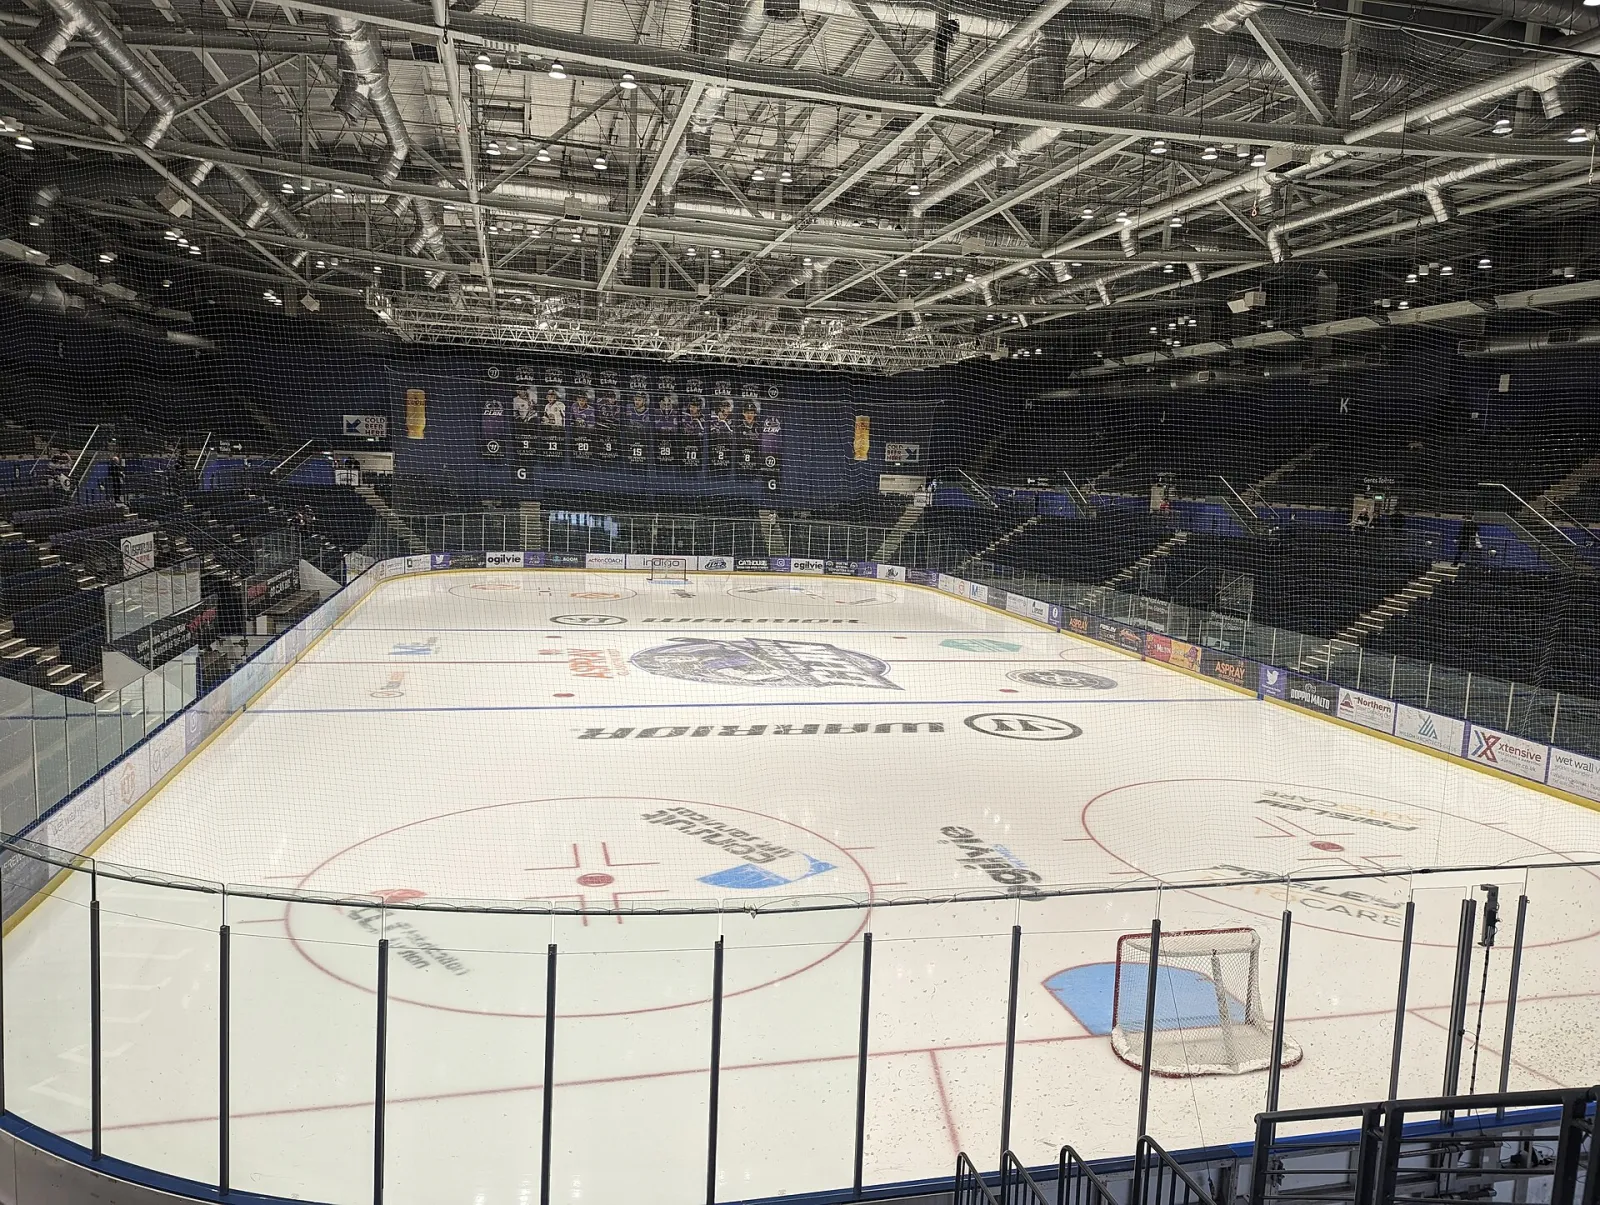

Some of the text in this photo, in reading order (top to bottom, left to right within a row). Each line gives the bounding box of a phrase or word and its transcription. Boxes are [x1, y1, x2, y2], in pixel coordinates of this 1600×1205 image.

[1340, 397, 1349, 413] K
[364, 416, 386, 424] COLD
[548, 442, 558, 451] 13
[578, 443, 589, 451] 20
[632, 448, 642, 456] 15
[660, 447, 671, 456] 29
[686, 451, 697, 460] 10
[718, 452, 724, 460] 2
[744, 454, 751, 462] 8
[516, 468, 527, 480] G
[767, 479, 777, 490] G
[487, 553, 521, 566] ogilvie
[642, 557, 680, 568] indigo
[793, 560, 823, 571] ogilvie
[1069, 617, 1089, 631] ASPRAY
[566, 648, 614, 679] ASPRAY
[1215, 660, 1246, 680] ASPRAY
[1290, 688, 1311, 703] DOPPIO
[1310, 694, 1330, 710] MALTO
[1356, 696, 1392, 713] Northern
[576, 721, 946, 741] WARRIOR
[1498, 742, 1542, 763] xtensive
[1555, 755, 1573, 767] wet
[1574, 760, 1594, 773] wall
[640, 809, 777, 864] consult
[1213, 864, 1406, 910] PASLEY
